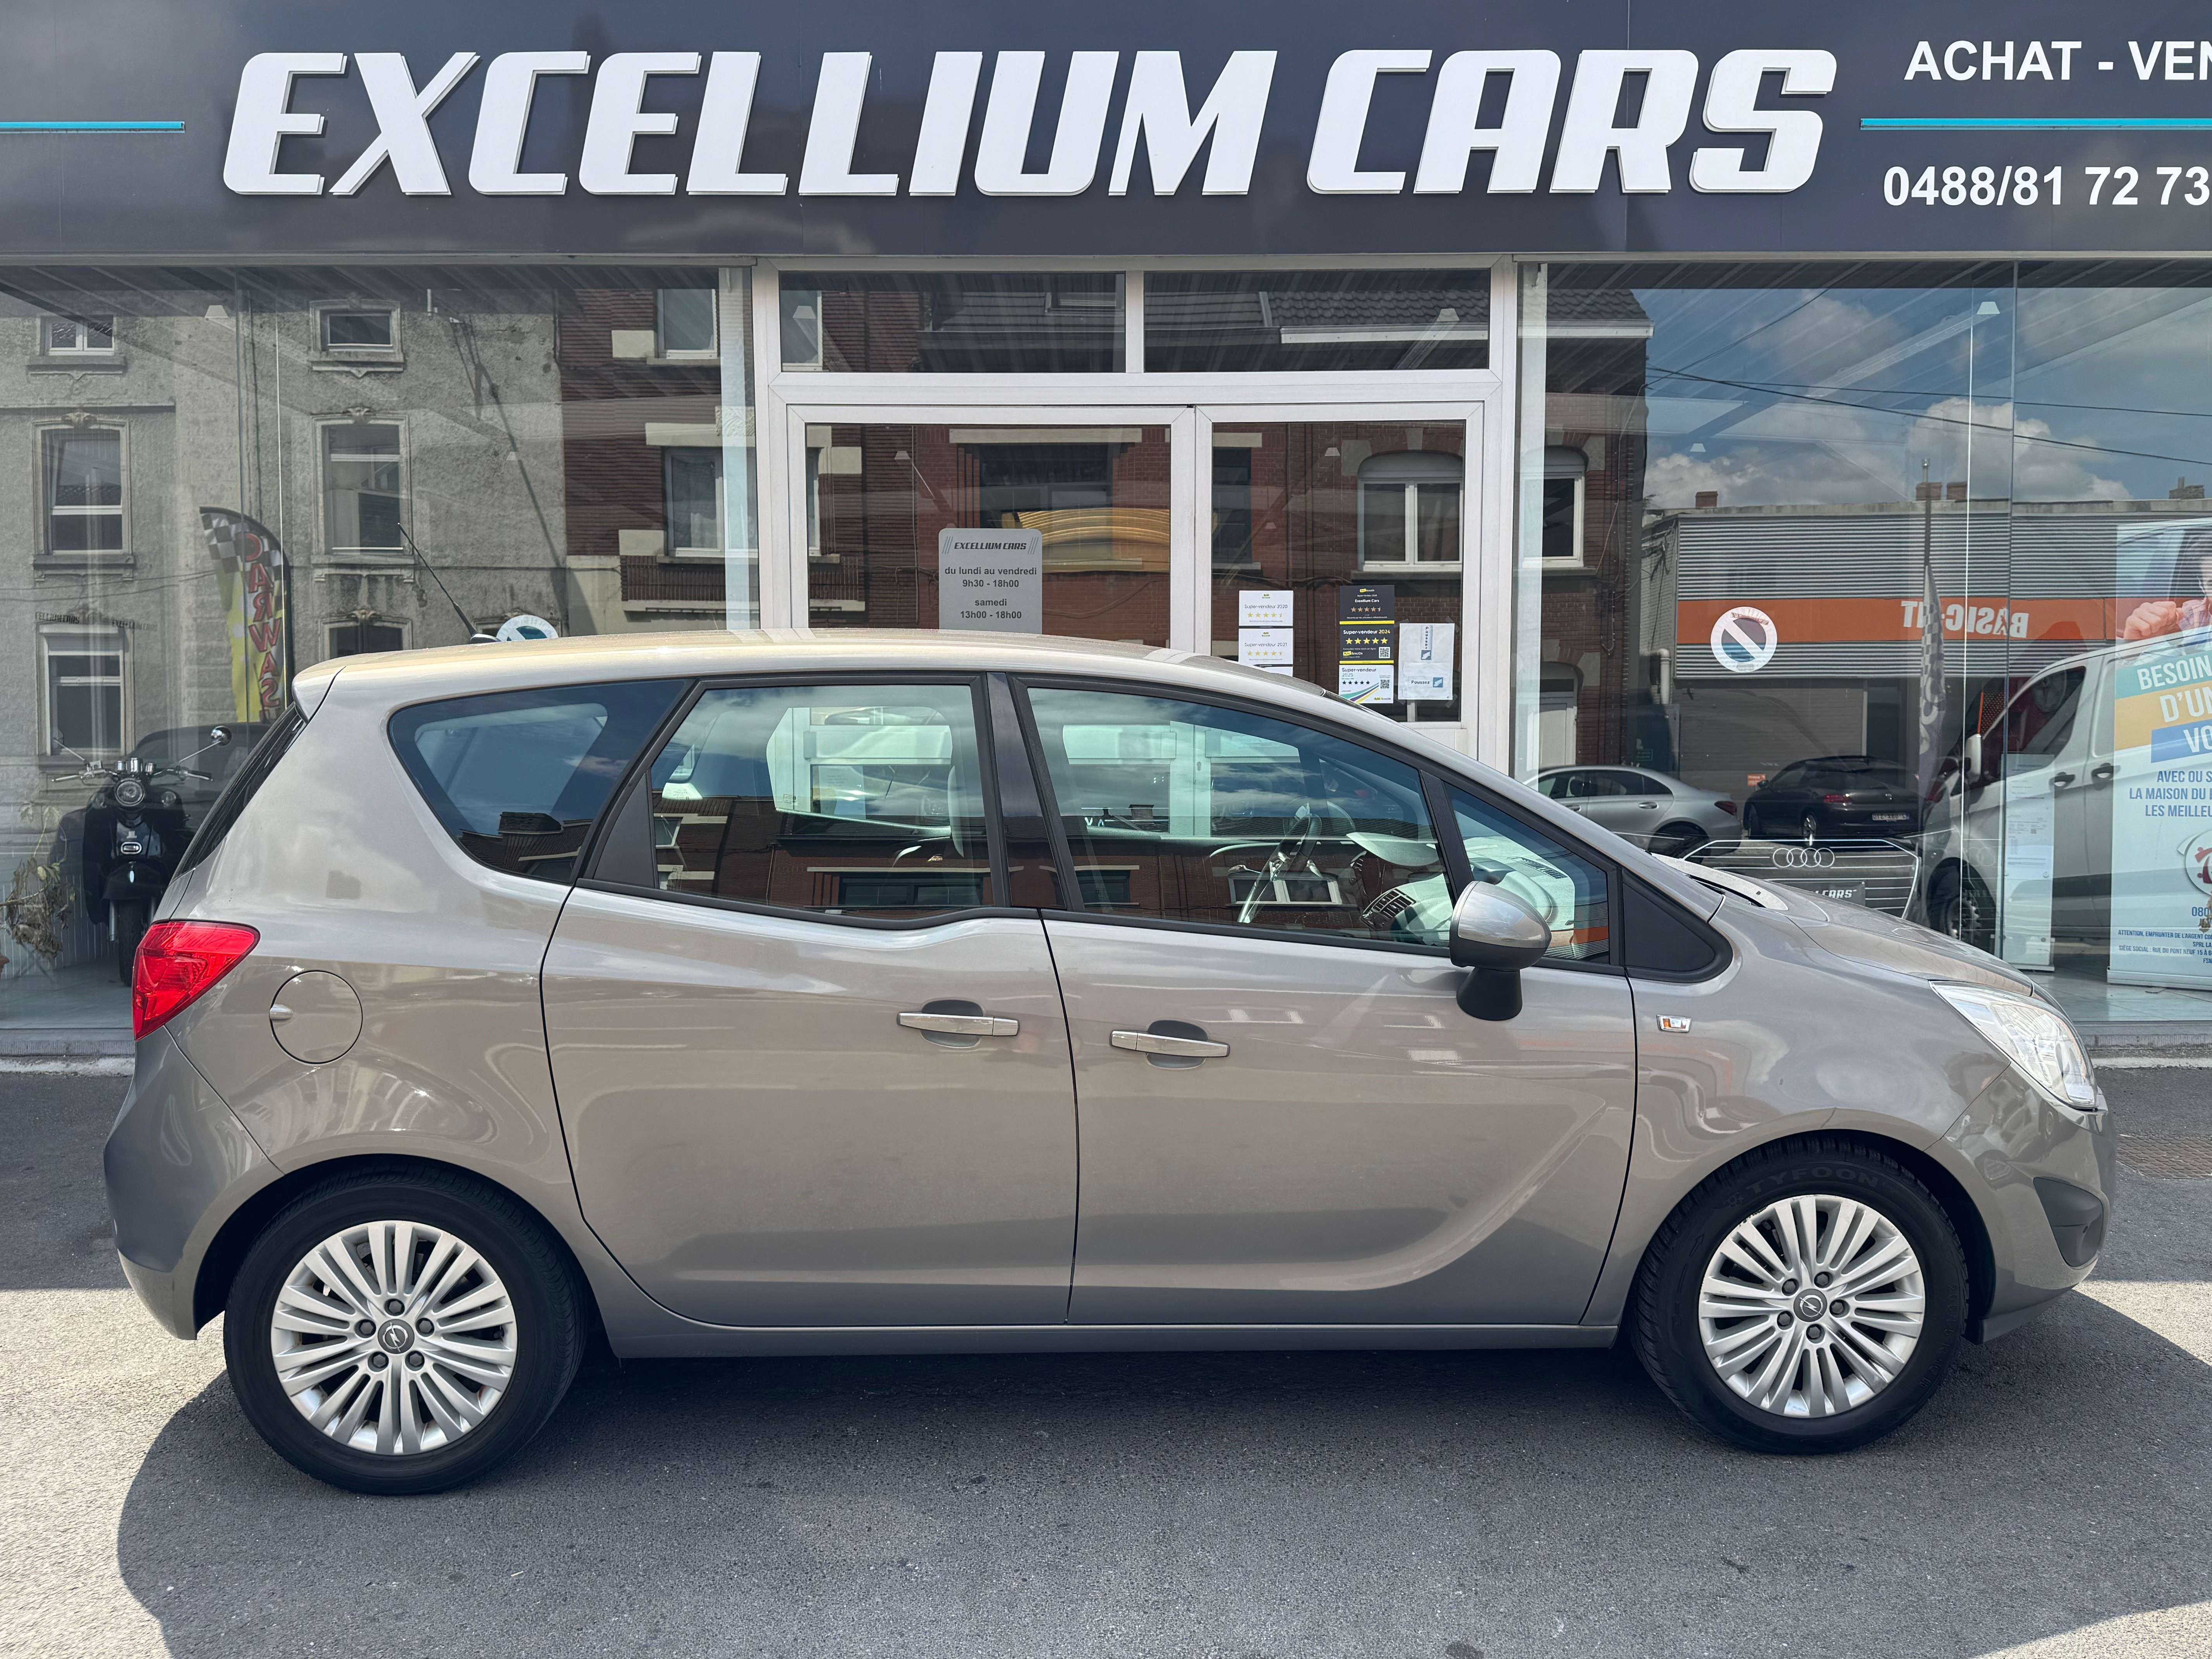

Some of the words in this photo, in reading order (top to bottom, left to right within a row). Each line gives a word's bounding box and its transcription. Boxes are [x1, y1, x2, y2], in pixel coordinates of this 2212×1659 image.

[1904, 40, 2081, 81] ACHAT
[2098, 62, 2113, 70] -
[223, 50, 1278, 196] EXCELLIUM
[1307, 49, 1837, 194] CARS
[1884, 165, 2062, 206] 0488/81
[2085, 166, 2138, 205] 72
[2156, 166, 2210, 206] 73
[2137, 655, 2212, 690] BESOIN
[2157, 771, 2185, 782] AVEC
[2188, 771, 2202, 782] OU
[2130, 788, 2142, 799] LA
[2146, 788, 2188, 799] MAISON
[2191, 788, 2206, 799] DU
[2145, 805, 2164, 816] LES
[1822, 890, 1853, 898] CARS
[1745, 1166, 1879, 1195] TYFOON
